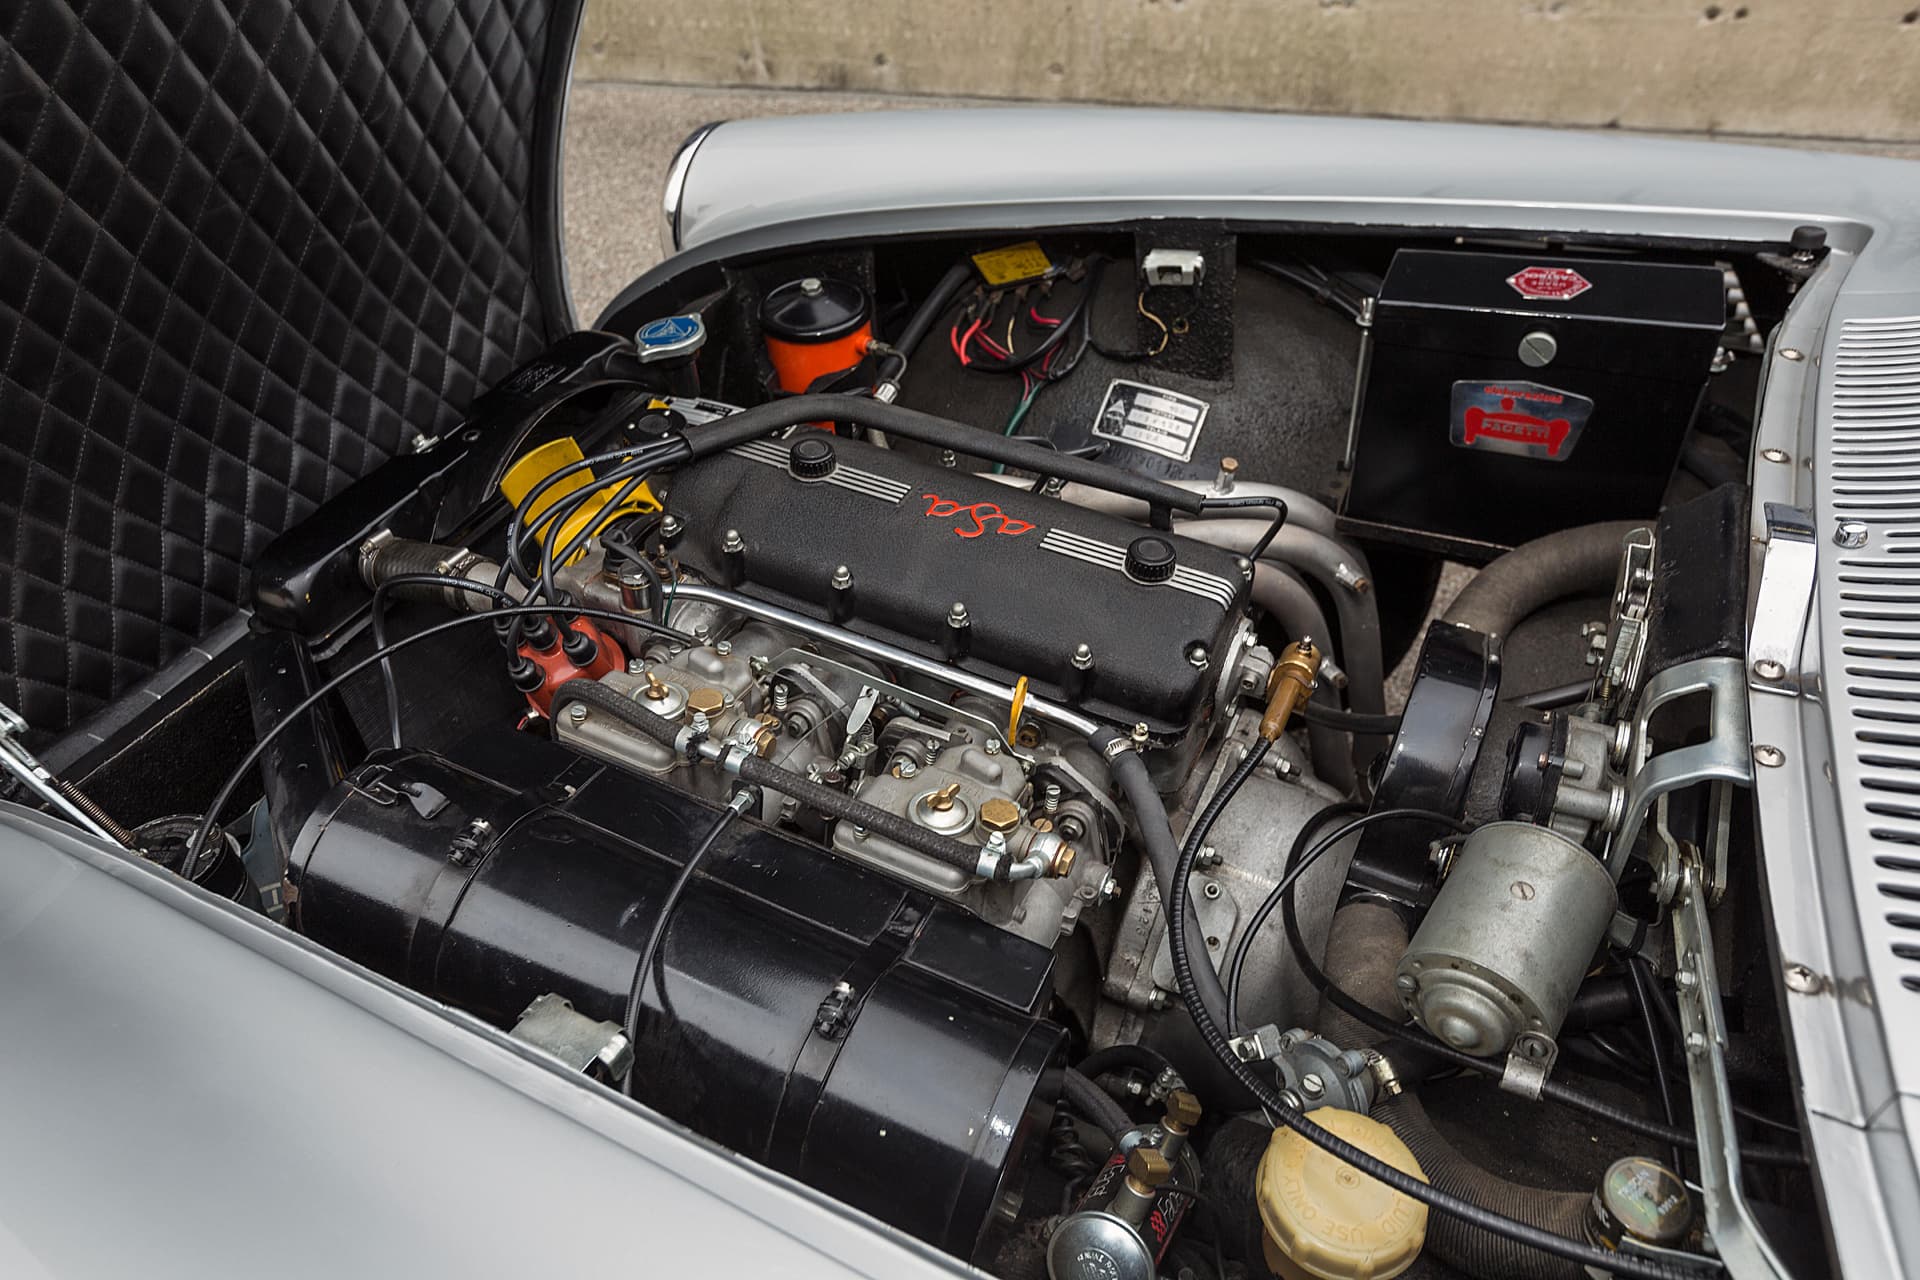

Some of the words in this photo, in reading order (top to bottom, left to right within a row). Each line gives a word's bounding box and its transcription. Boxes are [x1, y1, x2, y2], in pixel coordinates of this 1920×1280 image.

[1481, 418, 1551, 440] FACETTI
[1281, 1179, 1318, 1220] ONLY
[1321, 1221, 1366, 1244] USE
